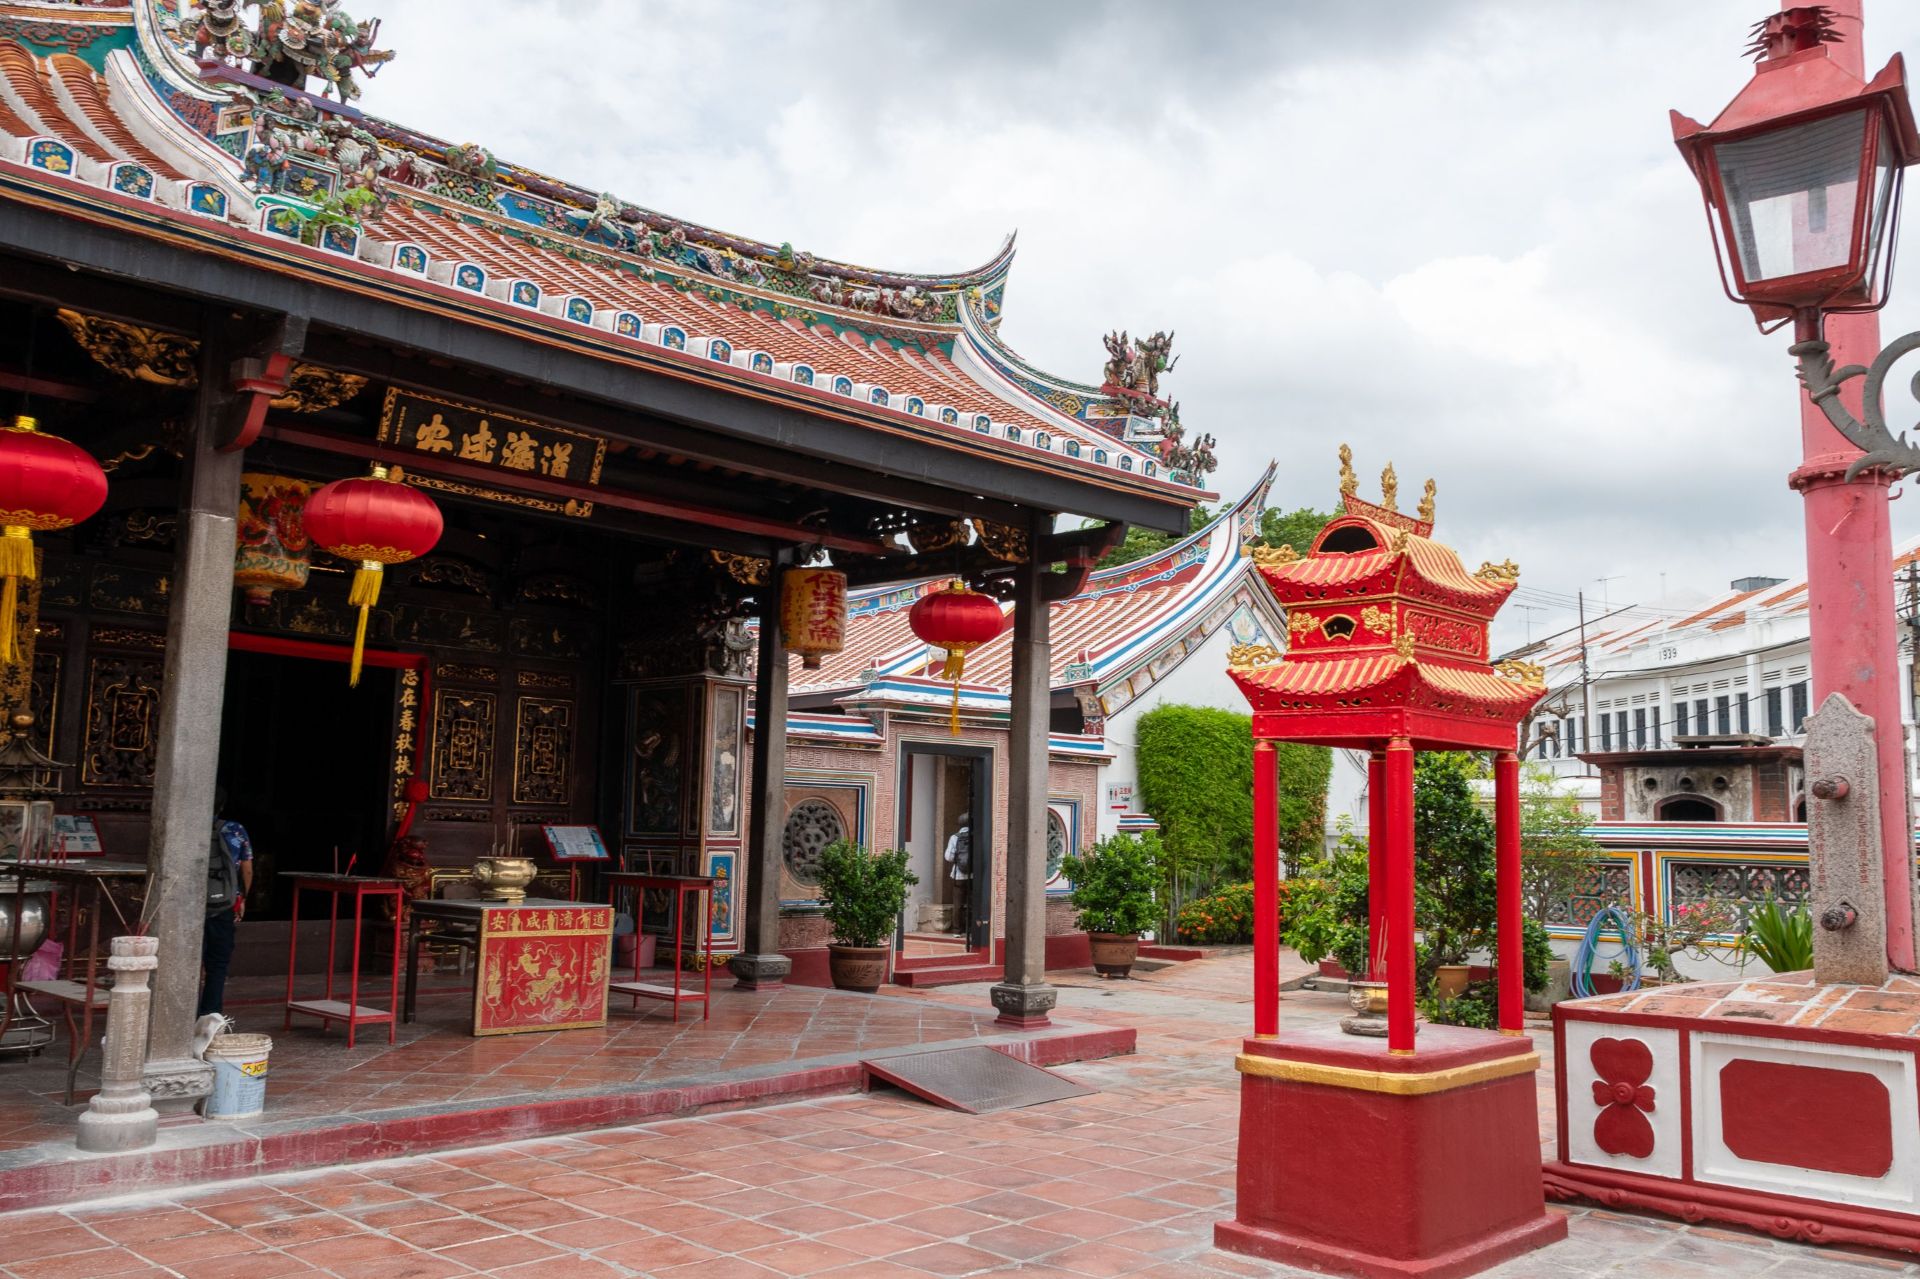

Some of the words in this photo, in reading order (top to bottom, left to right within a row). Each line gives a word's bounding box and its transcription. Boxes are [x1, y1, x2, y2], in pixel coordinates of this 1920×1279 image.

[1659, 648, 1677, 660] 1939
[394, 669, 420, 821] 志在春秋扶室
